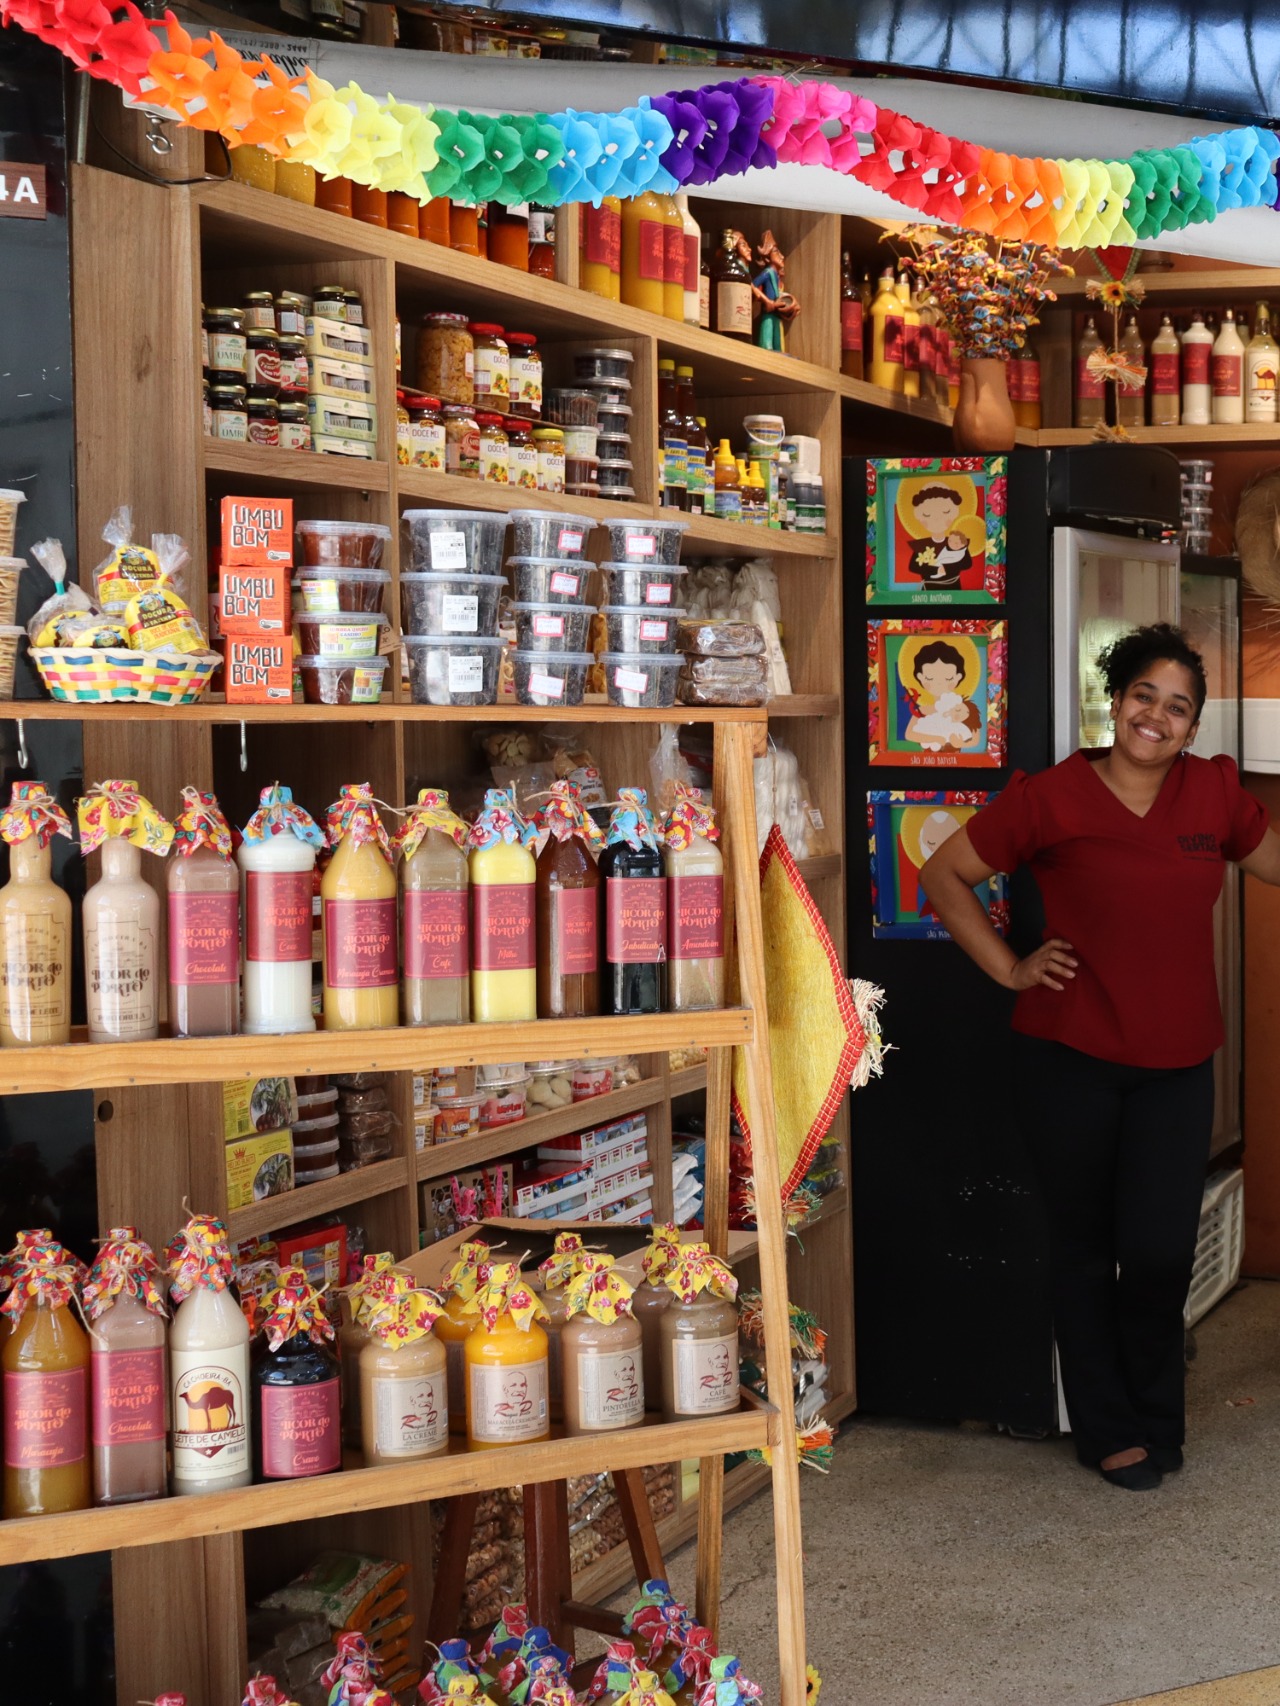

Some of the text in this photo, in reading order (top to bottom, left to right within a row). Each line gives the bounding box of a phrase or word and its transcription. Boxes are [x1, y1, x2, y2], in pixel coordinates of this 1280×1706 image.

[232, 504, 284, 531] UMBU
[231, 525, 269, 548] BOM
[223, 573, 276, 599] UMBU
[223, 594, 260, 617] BOM
[232, 642, 284, 668] UMBU
[230, 663, 269, 686] BOM
[184, 963, 227, 975] Chocolate
[108, 1421, 153, 1435] Chocolate
[196, 1433, 208, 1443] DE
[211, 1426, 246, 1442] CAMELO
